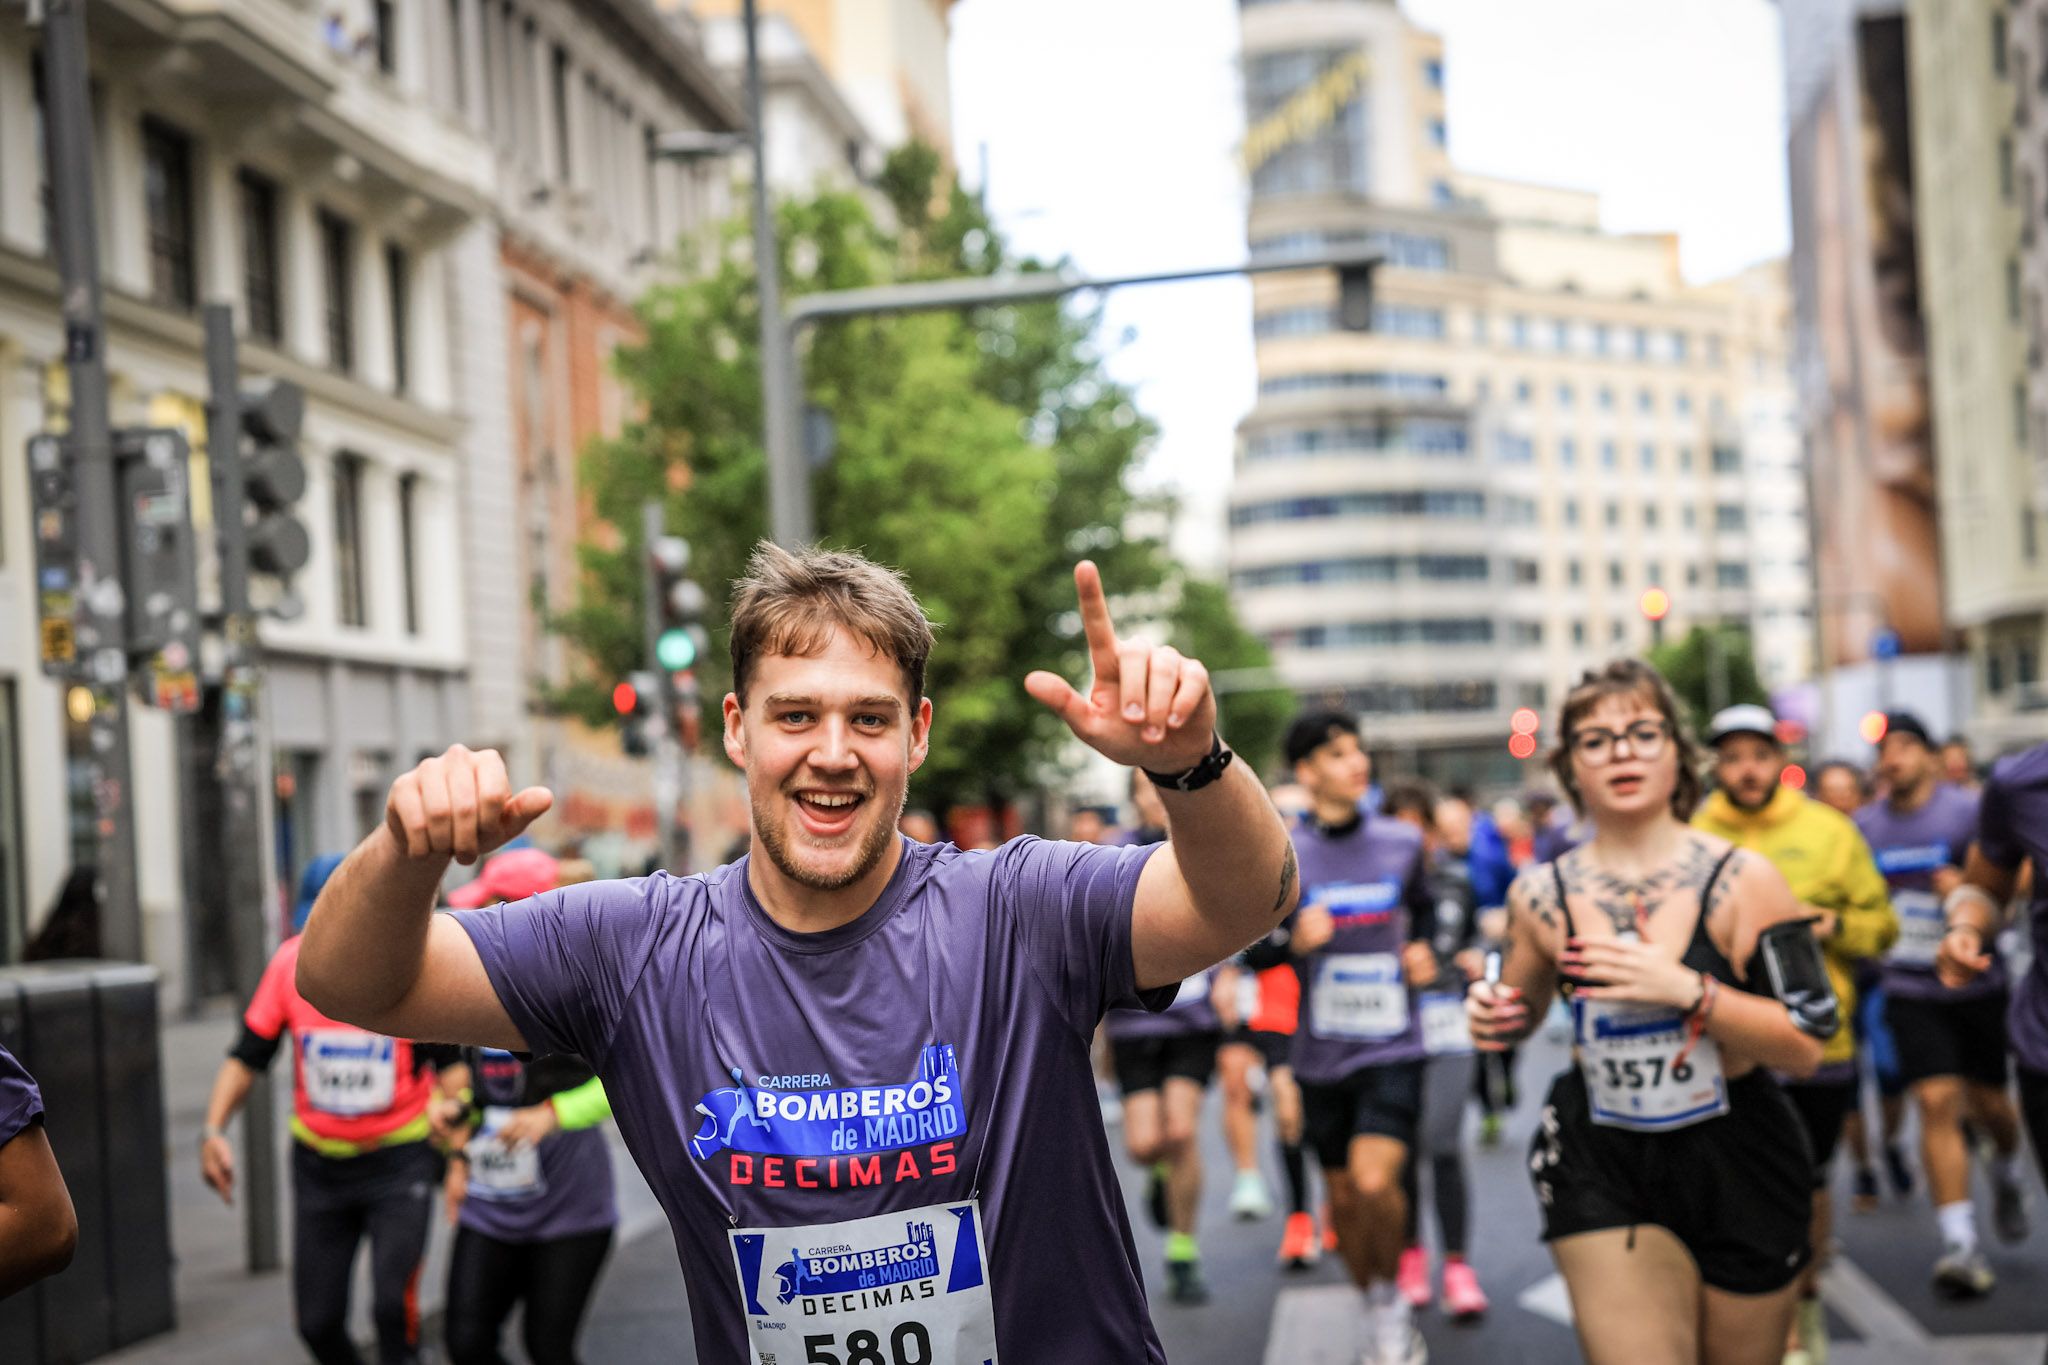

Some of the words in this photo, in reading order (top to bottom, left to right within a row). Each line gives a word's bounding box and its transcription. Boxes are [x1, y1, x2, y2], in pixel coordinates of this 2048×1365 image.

[758, 1073, 832, 1089] CARRERA
[1603, 1055, 1694, 1089] 3576
[756, 1075, 952, 1122] BOMBEROS
[831, 1120, 858, 1152] de
[865, 1104, 958, 1149] MADRID
[730, 1141, 957, 1188] DECIMAS
[808, 1244, 852, 1256] CARRERA
[809, 1241, 932, 1276] BOMBEROS
[858, 1270, 876, 1288] de
[880, 1257, 935, 1285] MADRID
[803, 1279, 935, 1316] DECIMAS
[763, 1322, 787, 1331] MADRID
